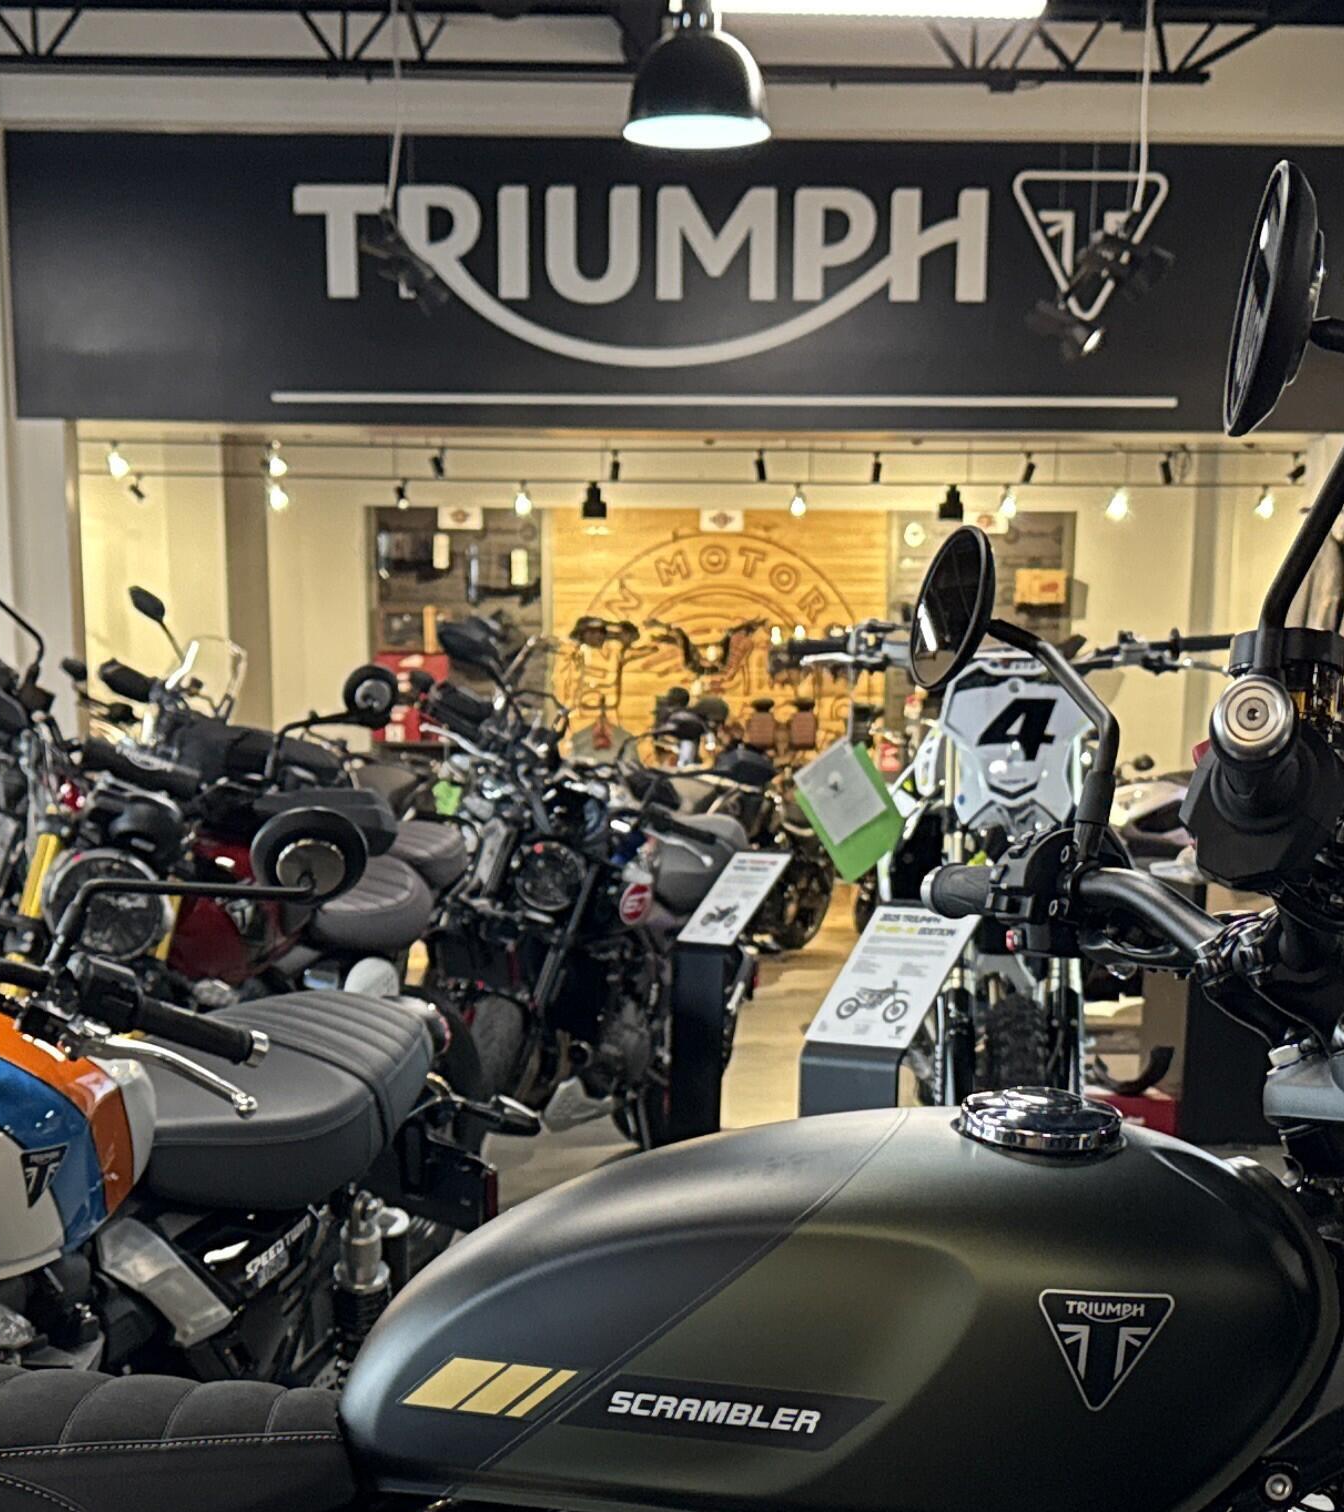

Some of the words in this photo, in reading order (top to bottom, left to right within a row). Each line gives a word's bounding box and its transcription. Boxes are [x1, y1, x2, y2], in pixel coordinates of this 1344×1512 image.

[293, 185, 990, 367] TRIUMPH
[977, 698, 1058, 762] 4
[1065, 1300, 1145, 1323] TRIUMPH
[608, 1390, 821, 1434] SCRAMBLER
